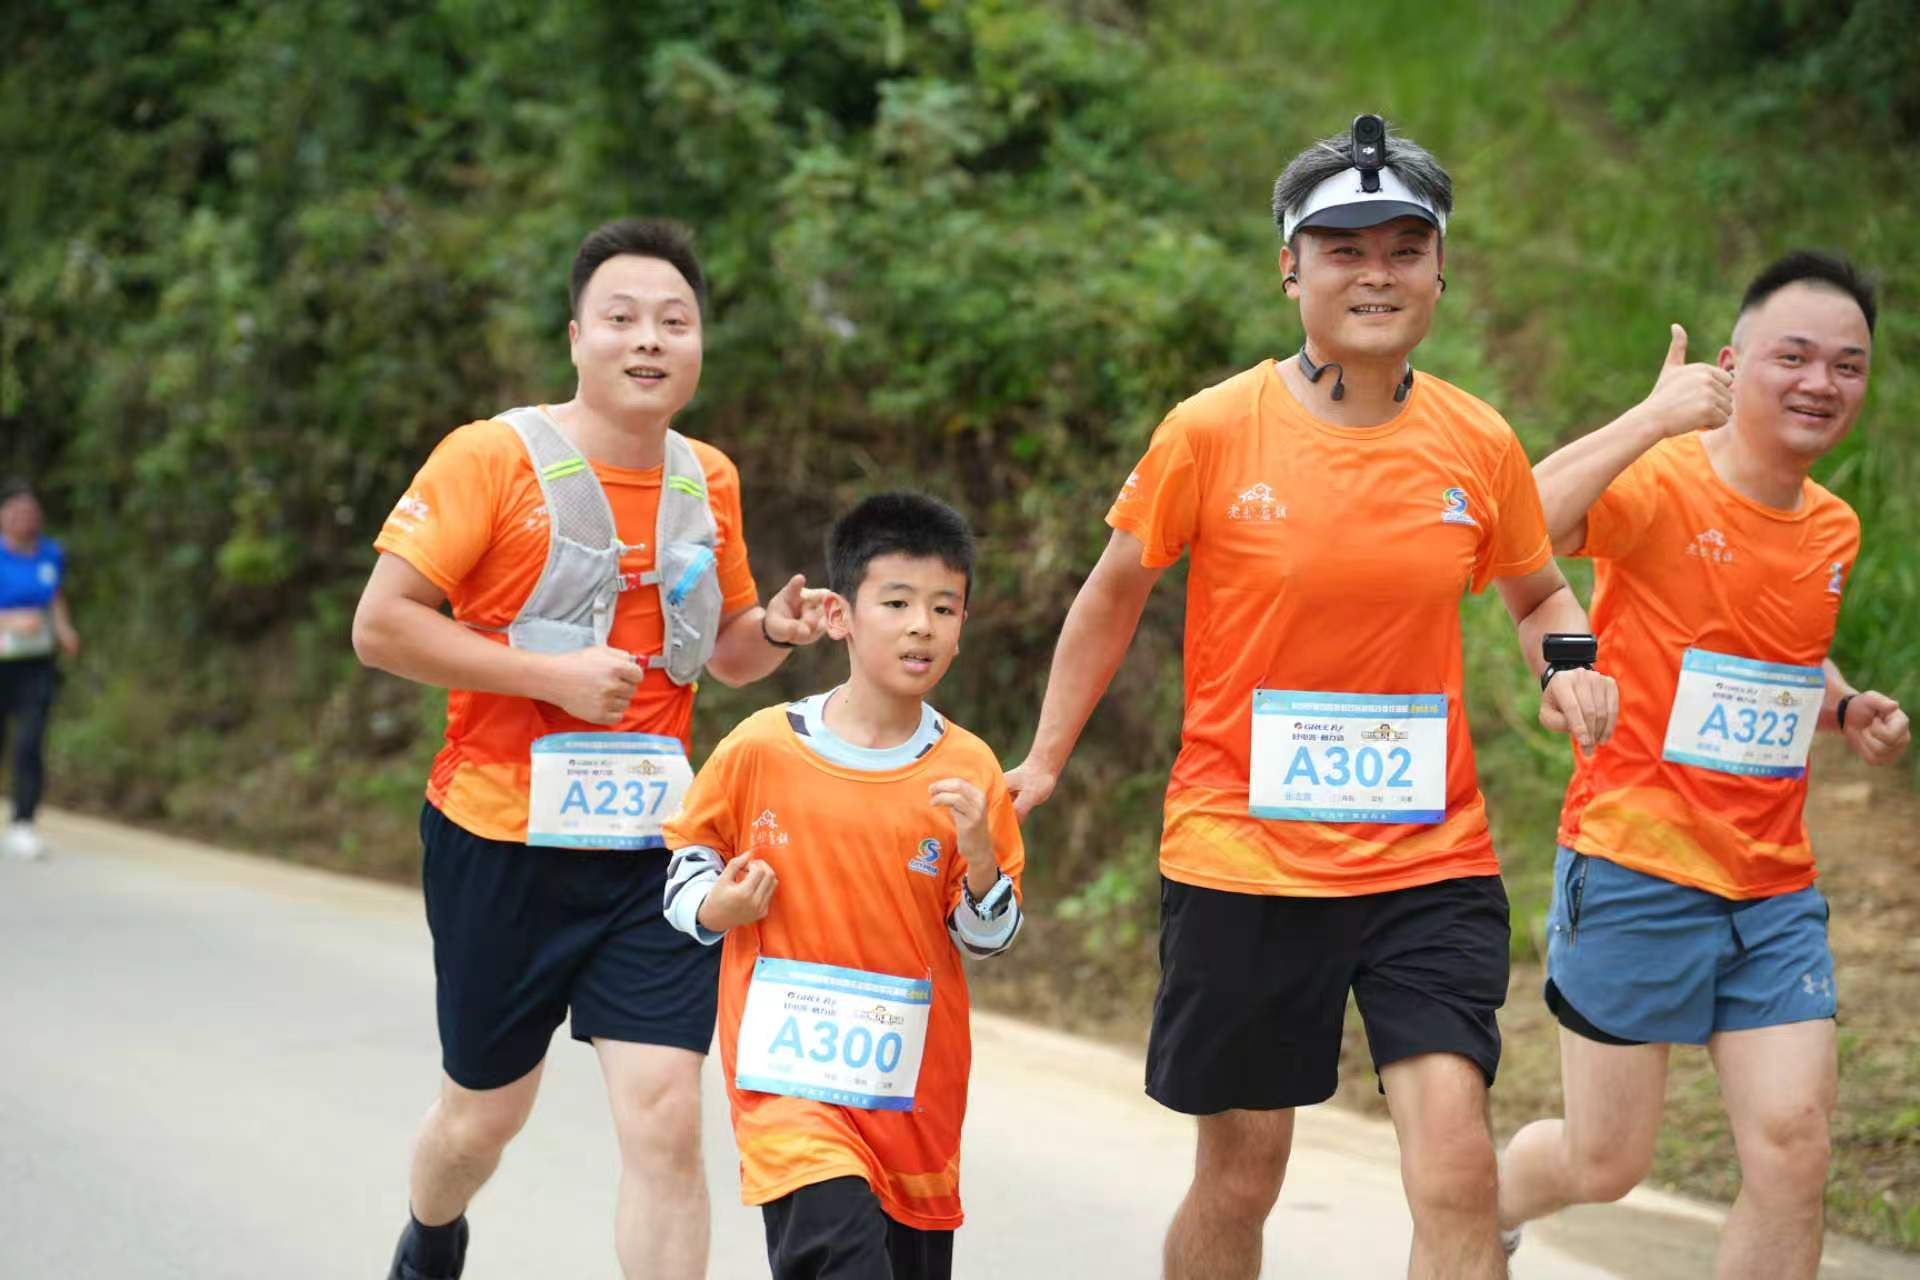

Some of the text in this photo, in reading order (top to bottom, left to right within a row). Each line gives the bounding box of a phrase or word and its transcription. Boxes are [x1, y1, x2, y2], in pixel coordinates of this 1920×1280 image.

[1697, 703, 1799, 747] A323
[1283, 745, 1413, 788] A302
[559, 779, 669, 817] A237
[768, 1015, 903, 1073] A300
